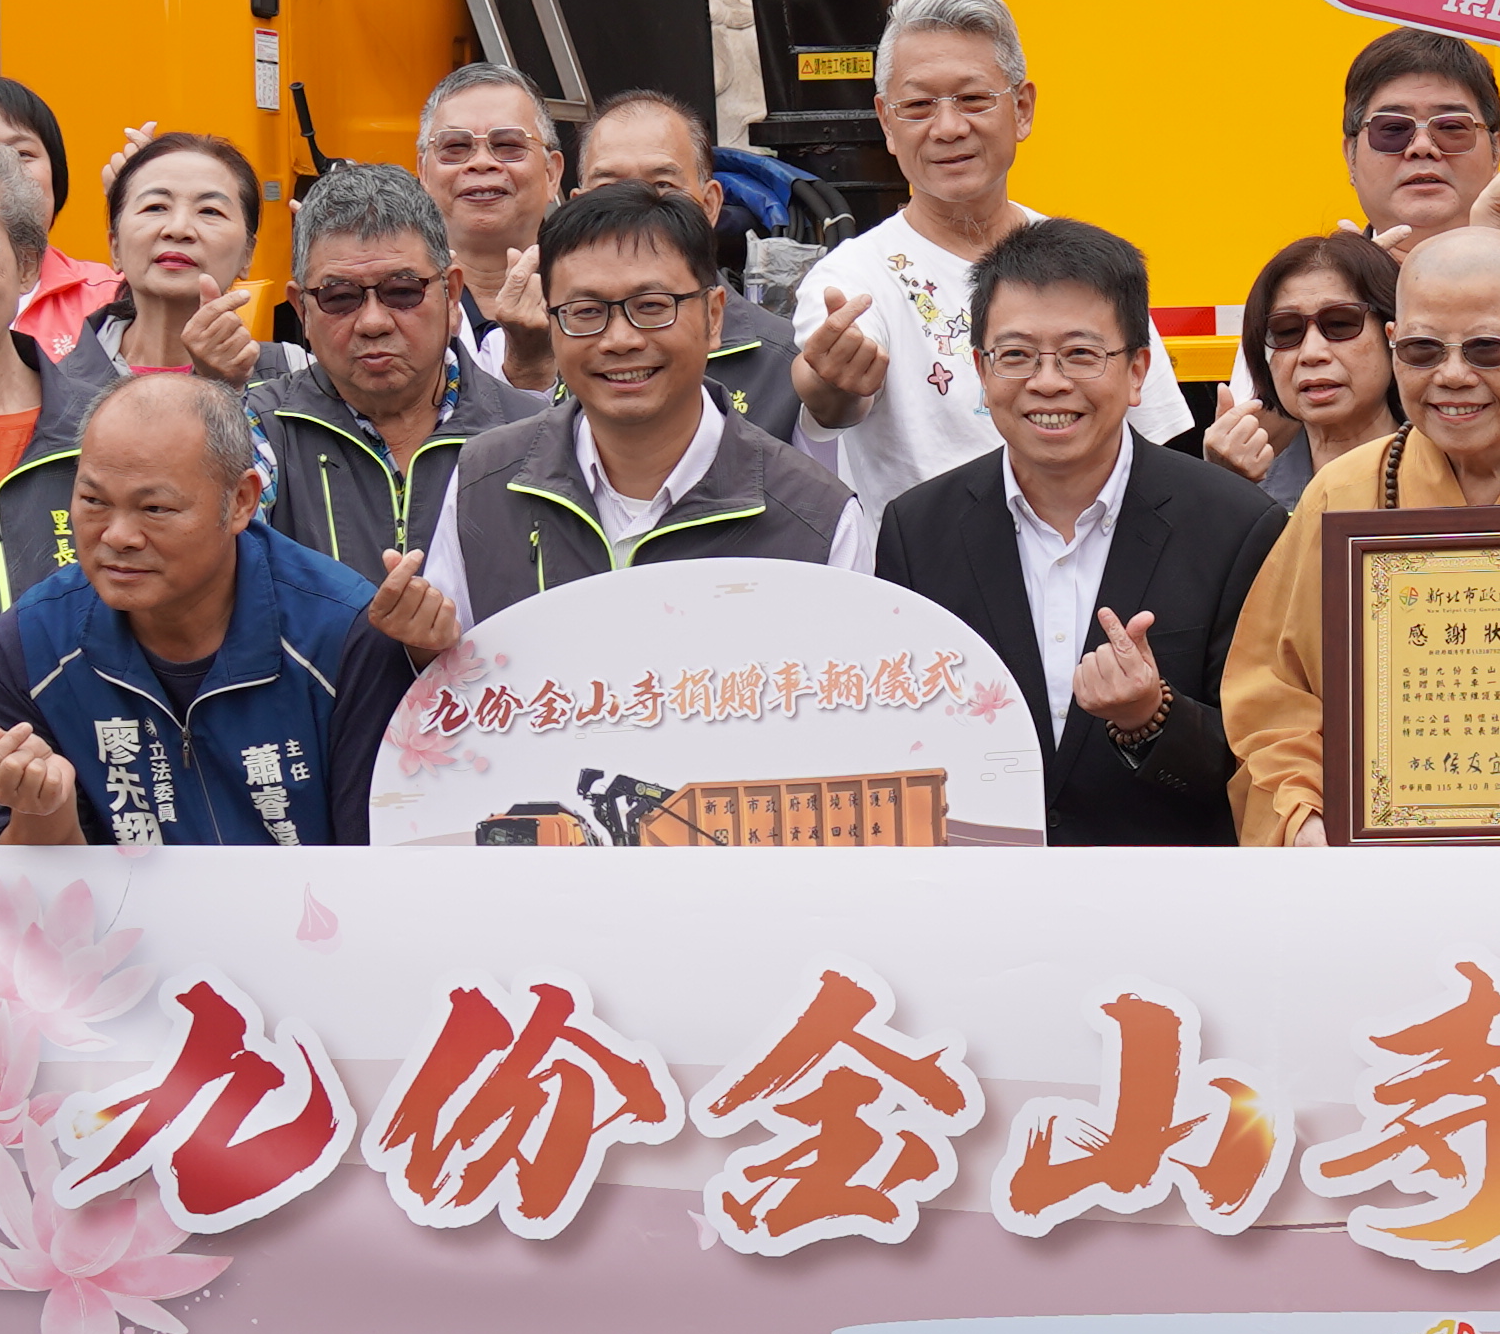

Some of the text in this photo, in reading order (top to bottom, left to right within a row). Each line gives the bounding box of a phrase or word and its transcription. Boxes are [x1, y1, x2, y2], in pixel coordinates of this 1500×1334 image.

[50, 508, 78, 568] 里長
[426, 651, 966, 733] 九份金山寺捐贈車輛儀式
[93, 716, 164, 846] 廖先翔
[149, 740, 178, 823] 立法委員
[285, 738, 311, 782] 主任
[1408, 756, 1436, 772] 市長
